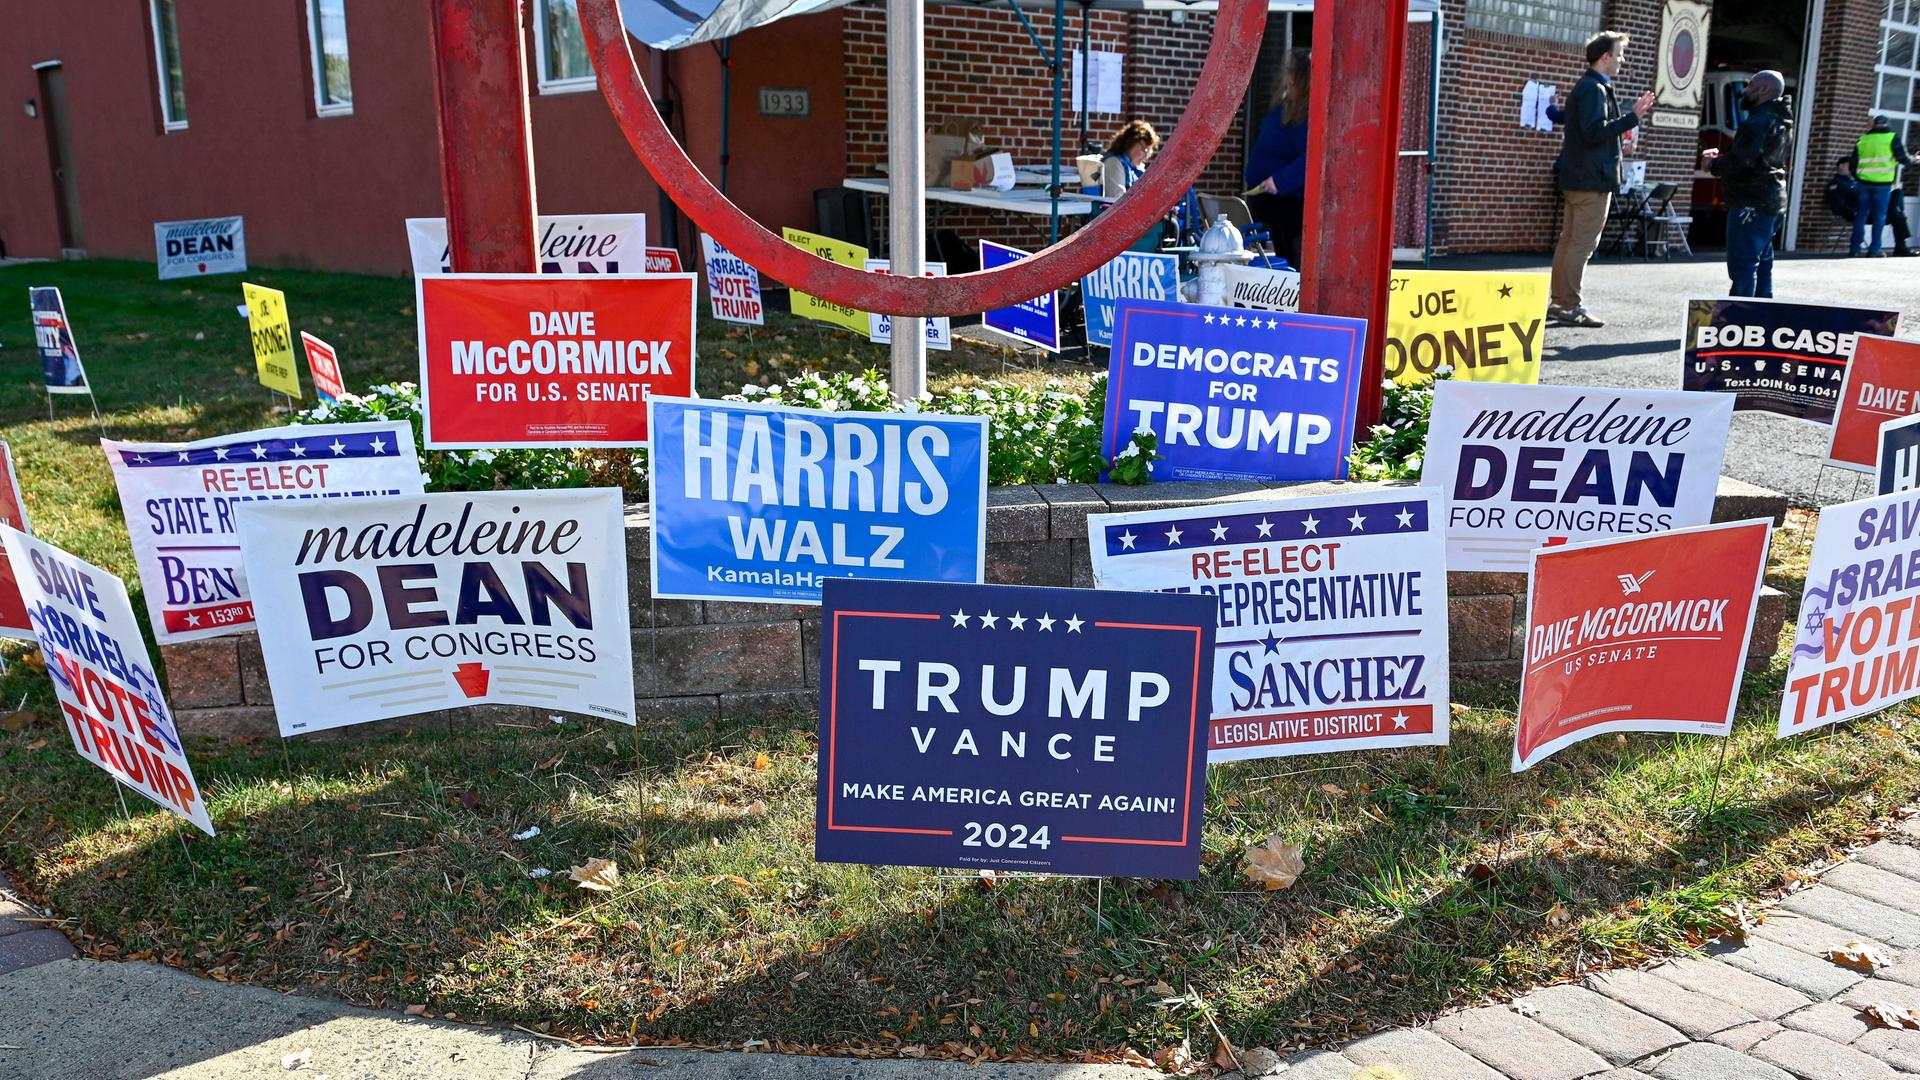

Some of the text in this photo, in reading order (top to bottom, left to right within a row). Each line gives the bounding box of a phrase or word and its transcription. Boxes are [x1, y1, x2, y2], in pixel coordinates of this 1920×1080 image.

[764, 94, 804, 111] 1933
[166, 234, 234, 257] DEAN
[788, 233, 811, 245] ELECT
[645, 256, 672, 272] RUMP
[711, 258, 750, 276] ISRAEL
[714, 277, 753, 299] VOTE
[810, 297, 837, 311] STATE
[1233, 275, 1300, 307] madelei
[1410, 289, 1457, 319] JOE
[528, 311, 596, 336] DAVE
[712, 297, 760, 320] TRUMP
[252, 322, 291, 357] ROONEY
[1385, 319, 1541, 377] OONEY
[1697, 325, 1854, 356] BOB CASE
[451, 340, 673, 375] McCORMICK
[1132, 342, 1339, 384] DEMOCRATS
[1696, 360, 1842, 381] U.S. SENA
[476, 383, 652, 403] FOR U.S. SENATE
[1209, 381, 1258, 402] FOR
[1724, 378, 1838, 398] Text JOIN to 51041
[1858, 382, 1909, 412] DAVE
[1129, 399, 1332, 455] TRUMP
[1462, 396, 1691, 446] madeleine
[202, 464, 329, 492] RE-ELECT
[683, 409, 950, 516] HARRIS
[1453, 444, 1685, 508] DEAN
[146, 497, 213, 536] STATE
[295, 502, 582, 566] madeleine
[1449, 507, 1672, 534] FOR CONGRESS
[727, 515, 905, 569] WALZ
[1192, 543, 1341, 580] RE-ELECT
[30, 548, 107, 623] SAVE
[157, 556, 242, 606] BEN
[298, 561, 593, 642] DEAN
[1200, 571, 1423, 629] EPRESENTATIVE
[36, 599, 142, 691] ISRAEL
[314, 632, 597, 675] FOR CONGRESS
[1531, 616, 1579, 665] DAVE
[1565, 646, 1657, 675] US SENATE
[858, 659, 1171, 722] TRUMP
[1229, 650, 1427, 712] SANCHEZ
[1790, 645, 1920, 726] TRUM
[56, 651, 167, 754] VOTE
[910, 726, 1116, 762] VANCE
[1214, 713, 1383, 746] LEGISLATIVE DISTRICT
[61, 700, 196, 815] TRUMP
[842, 782, 1176, 814] MAKE AMERICA GREAT AGAIN!
[962, 822, 1051, 850] 2024
